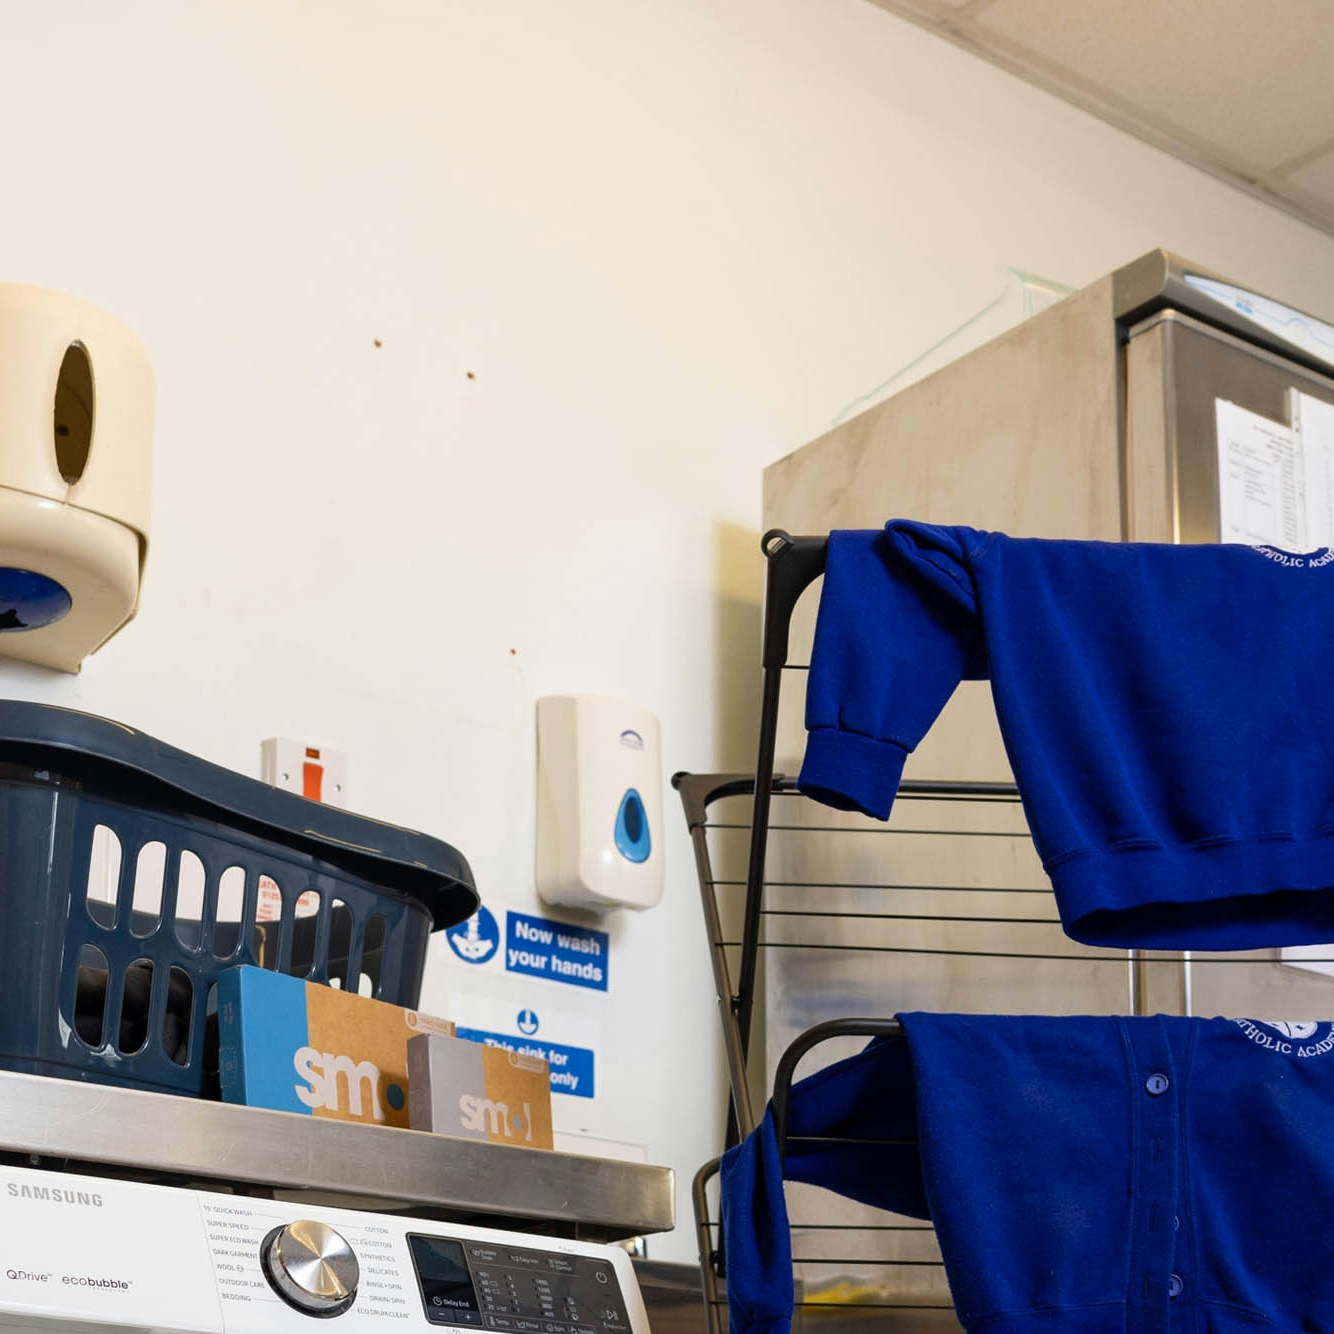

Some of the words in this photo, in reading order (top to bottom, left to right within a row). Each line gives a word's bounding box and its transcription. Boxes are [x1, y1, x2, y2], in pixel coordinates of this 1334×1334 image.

[515, 920, 554, 945] Now
[557, 933, 602, 956] wash
[508, 948, 548, 969] your
[551, 954, 604, 982] hands
[517, 1045, 547, 1062] sink
[549, 1050, 569, 1066] for
[550, 1071, 579, 1091] only
[7, 1182, 104, 1208] SAMSUNG
[216, 1263, 236, 1272] WOOL
[221, 1292, 252, 1303] BEDDING
